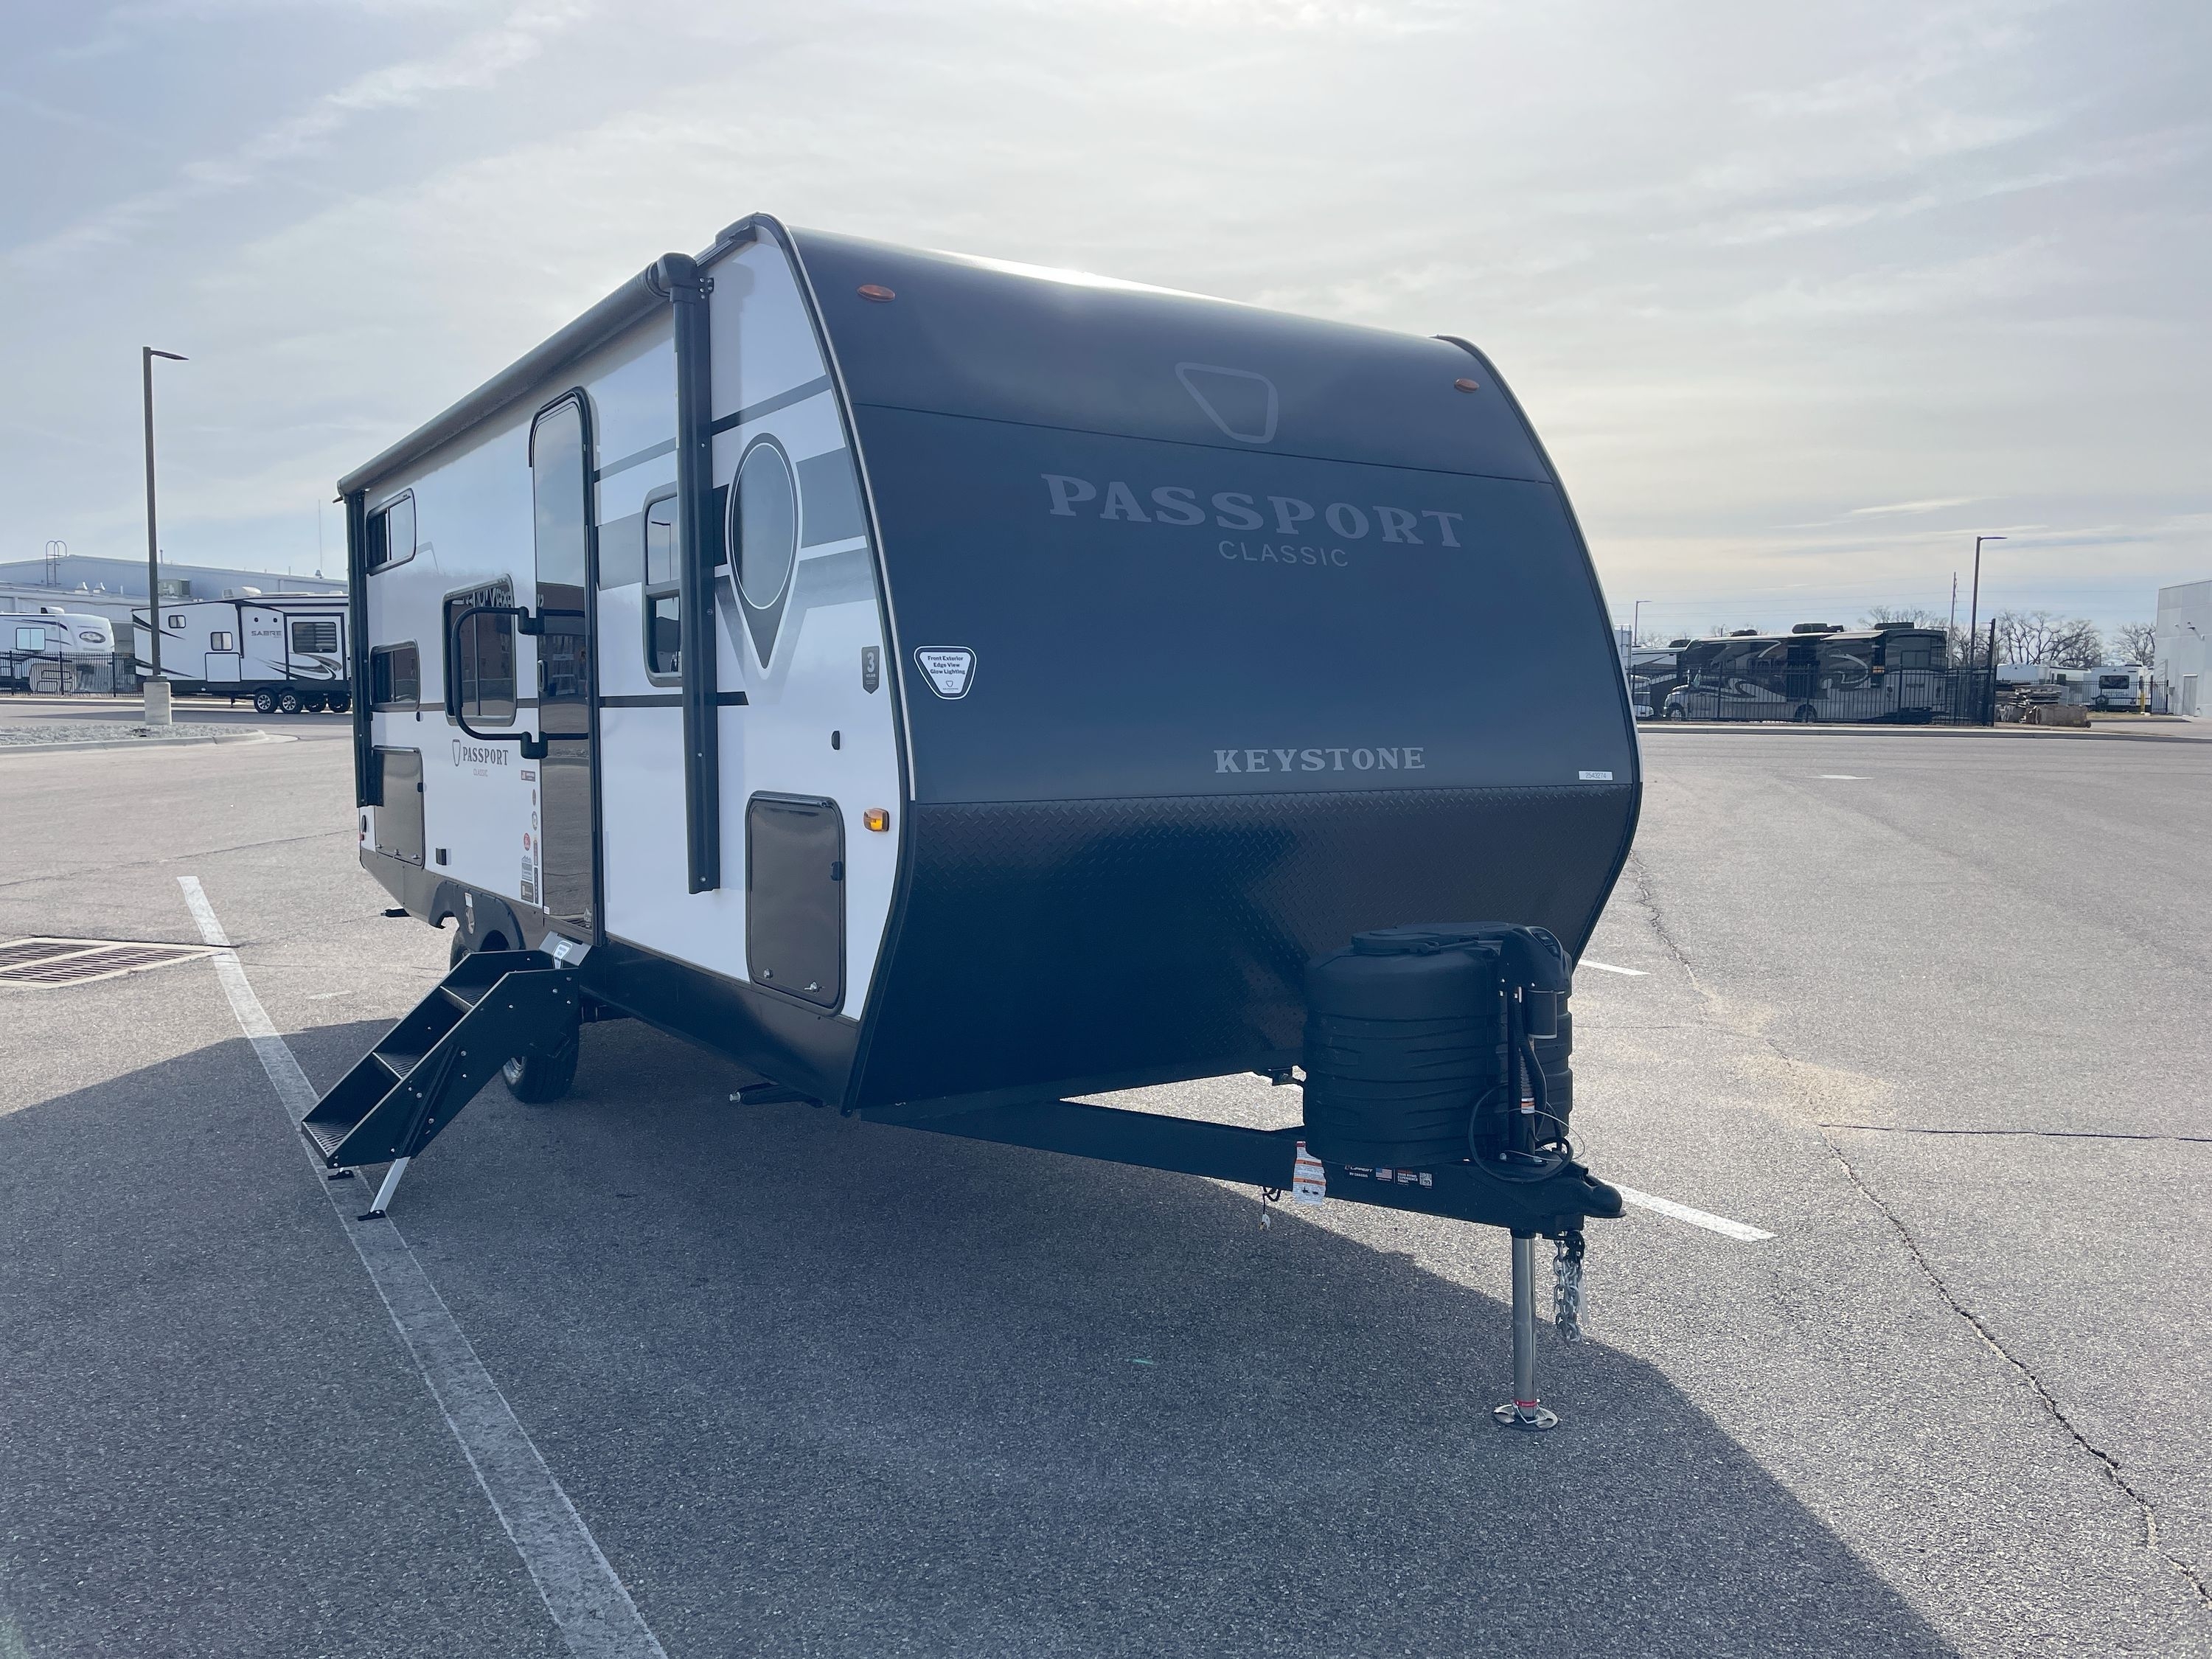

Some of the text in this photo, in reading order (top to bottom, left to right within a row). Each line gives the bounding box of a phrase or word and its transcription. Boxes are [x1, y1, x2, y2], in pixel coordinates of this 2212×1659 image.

[1040, 473, 1464, 548] PASSPORT
[1218, 540, 1349, 567] CLASSIC
[867, 652, 875, 672] 3
[463, 746, 509, 765] PASSPORT
[1214, 747, 1425, 773] KEYSTONE
